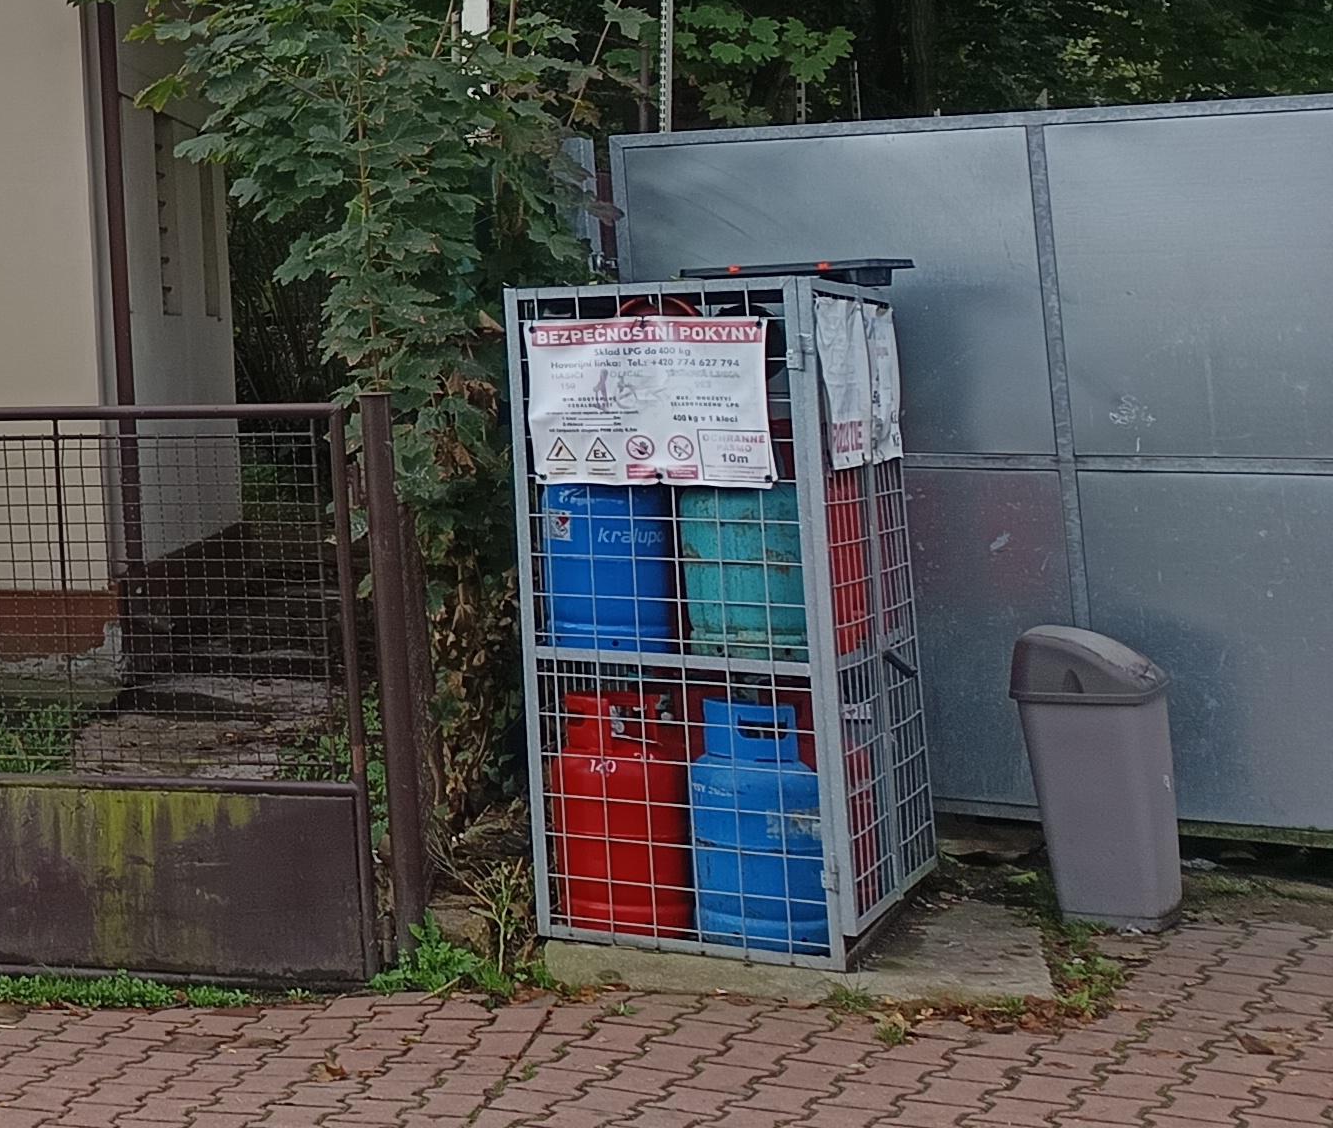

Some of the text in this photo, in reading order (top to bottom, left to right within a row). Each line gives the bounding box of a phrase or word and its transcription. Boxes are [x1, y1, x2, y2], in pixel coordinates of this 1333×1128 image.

[536, 323, 758, 345] BEZPEČNOSTNÍ POKYNY
[594, 346, 620, 356] Sklad
[622, 346, 642, 356] LPG
[658, 346, 676, 355] 400
[678, 346, 691, 357] kg
[651, 358, 674, 366] +420
[677, 358, 696, 366] 774
[699, 358, 717, 367] 627
[719, 358, 740, 367] 794
[673, 414, 687, 422] 400
[687, 414, 699, 423] kg
[702, 433, 766, 444] OCHRANNÉ
[593, 449, 607, 459] Ex
[721, 453, 749, 464] 10m
